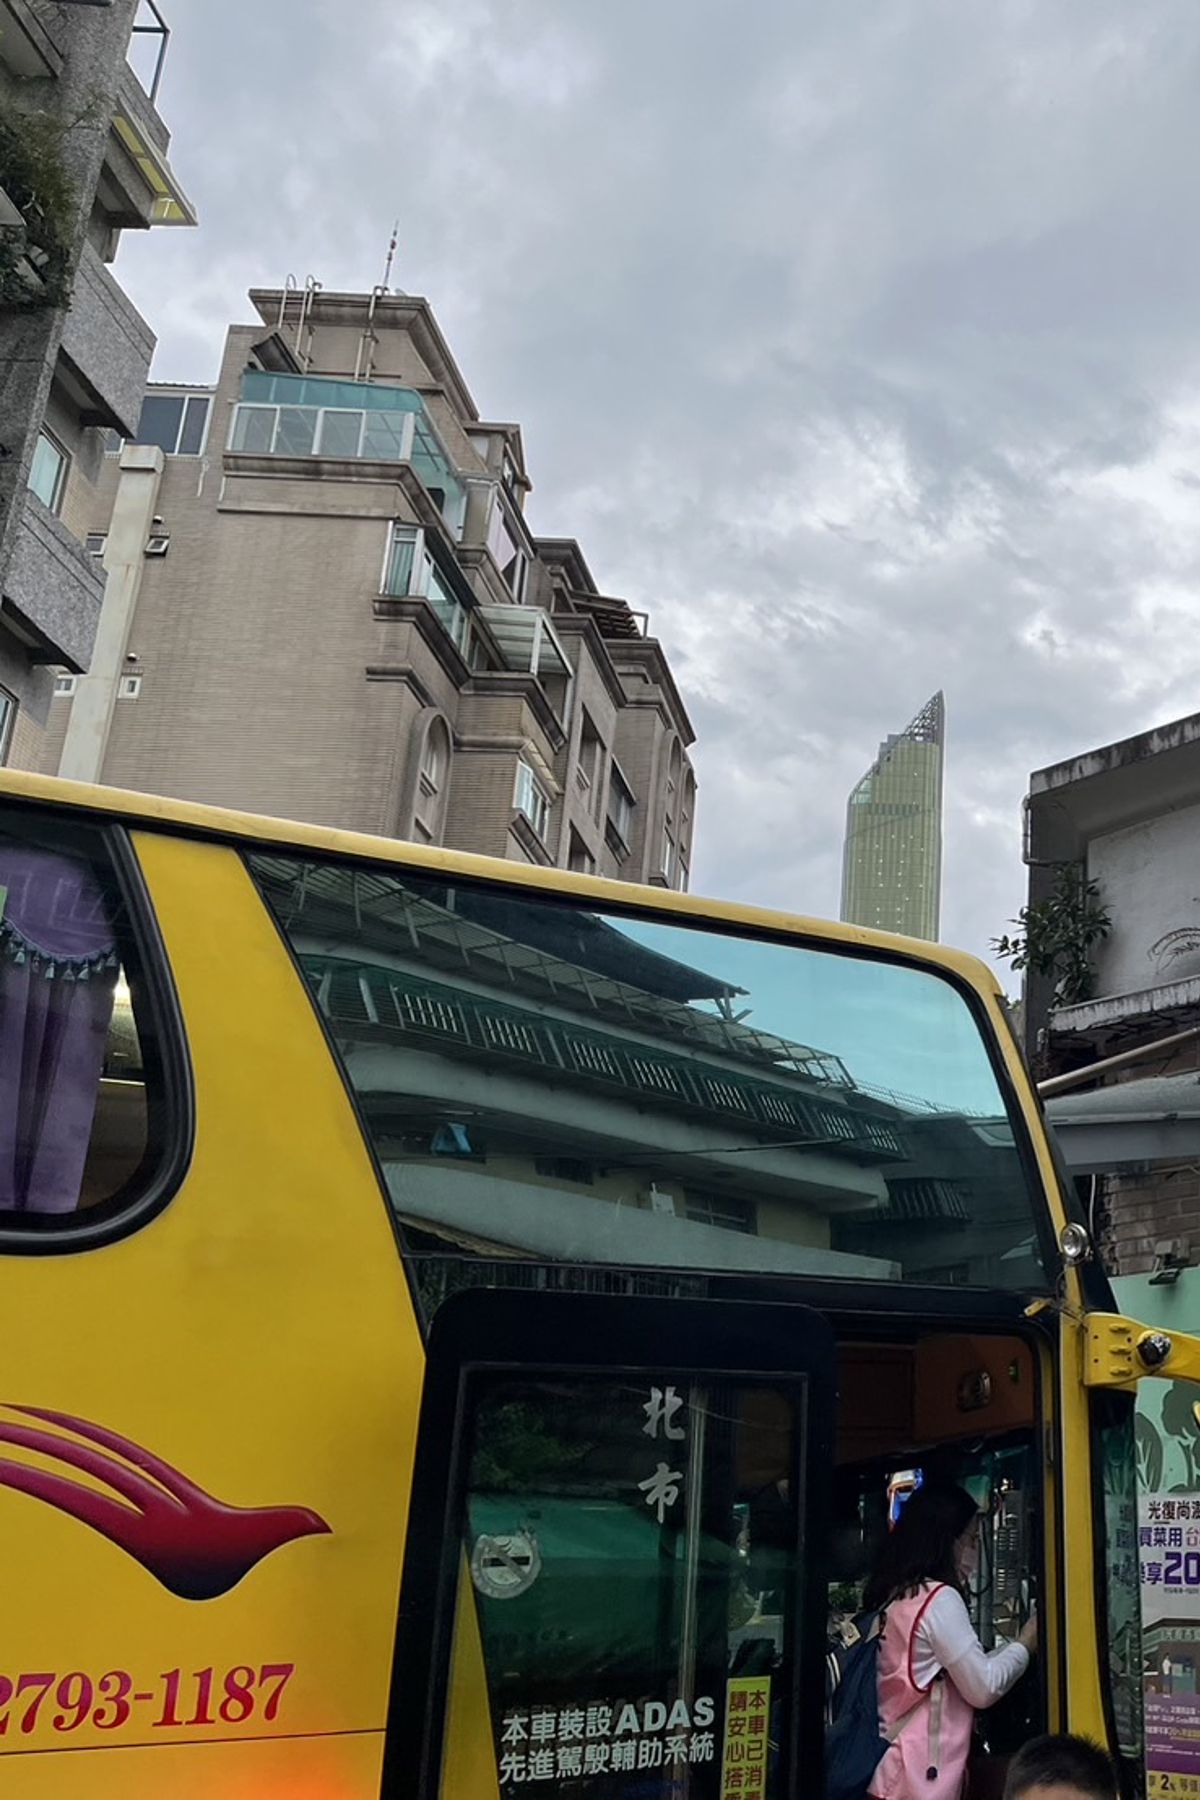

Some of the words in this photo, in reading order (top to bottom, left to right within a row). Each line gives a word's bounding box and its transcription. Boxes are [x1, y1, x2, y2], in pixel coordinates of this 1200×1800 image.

[637, 1386, 686, 1523] 北市
[501, 1696, 715, 1746] 本車裝設ADAS
[499, 1731, 715, 1785] 先進駕駛輔助系統
